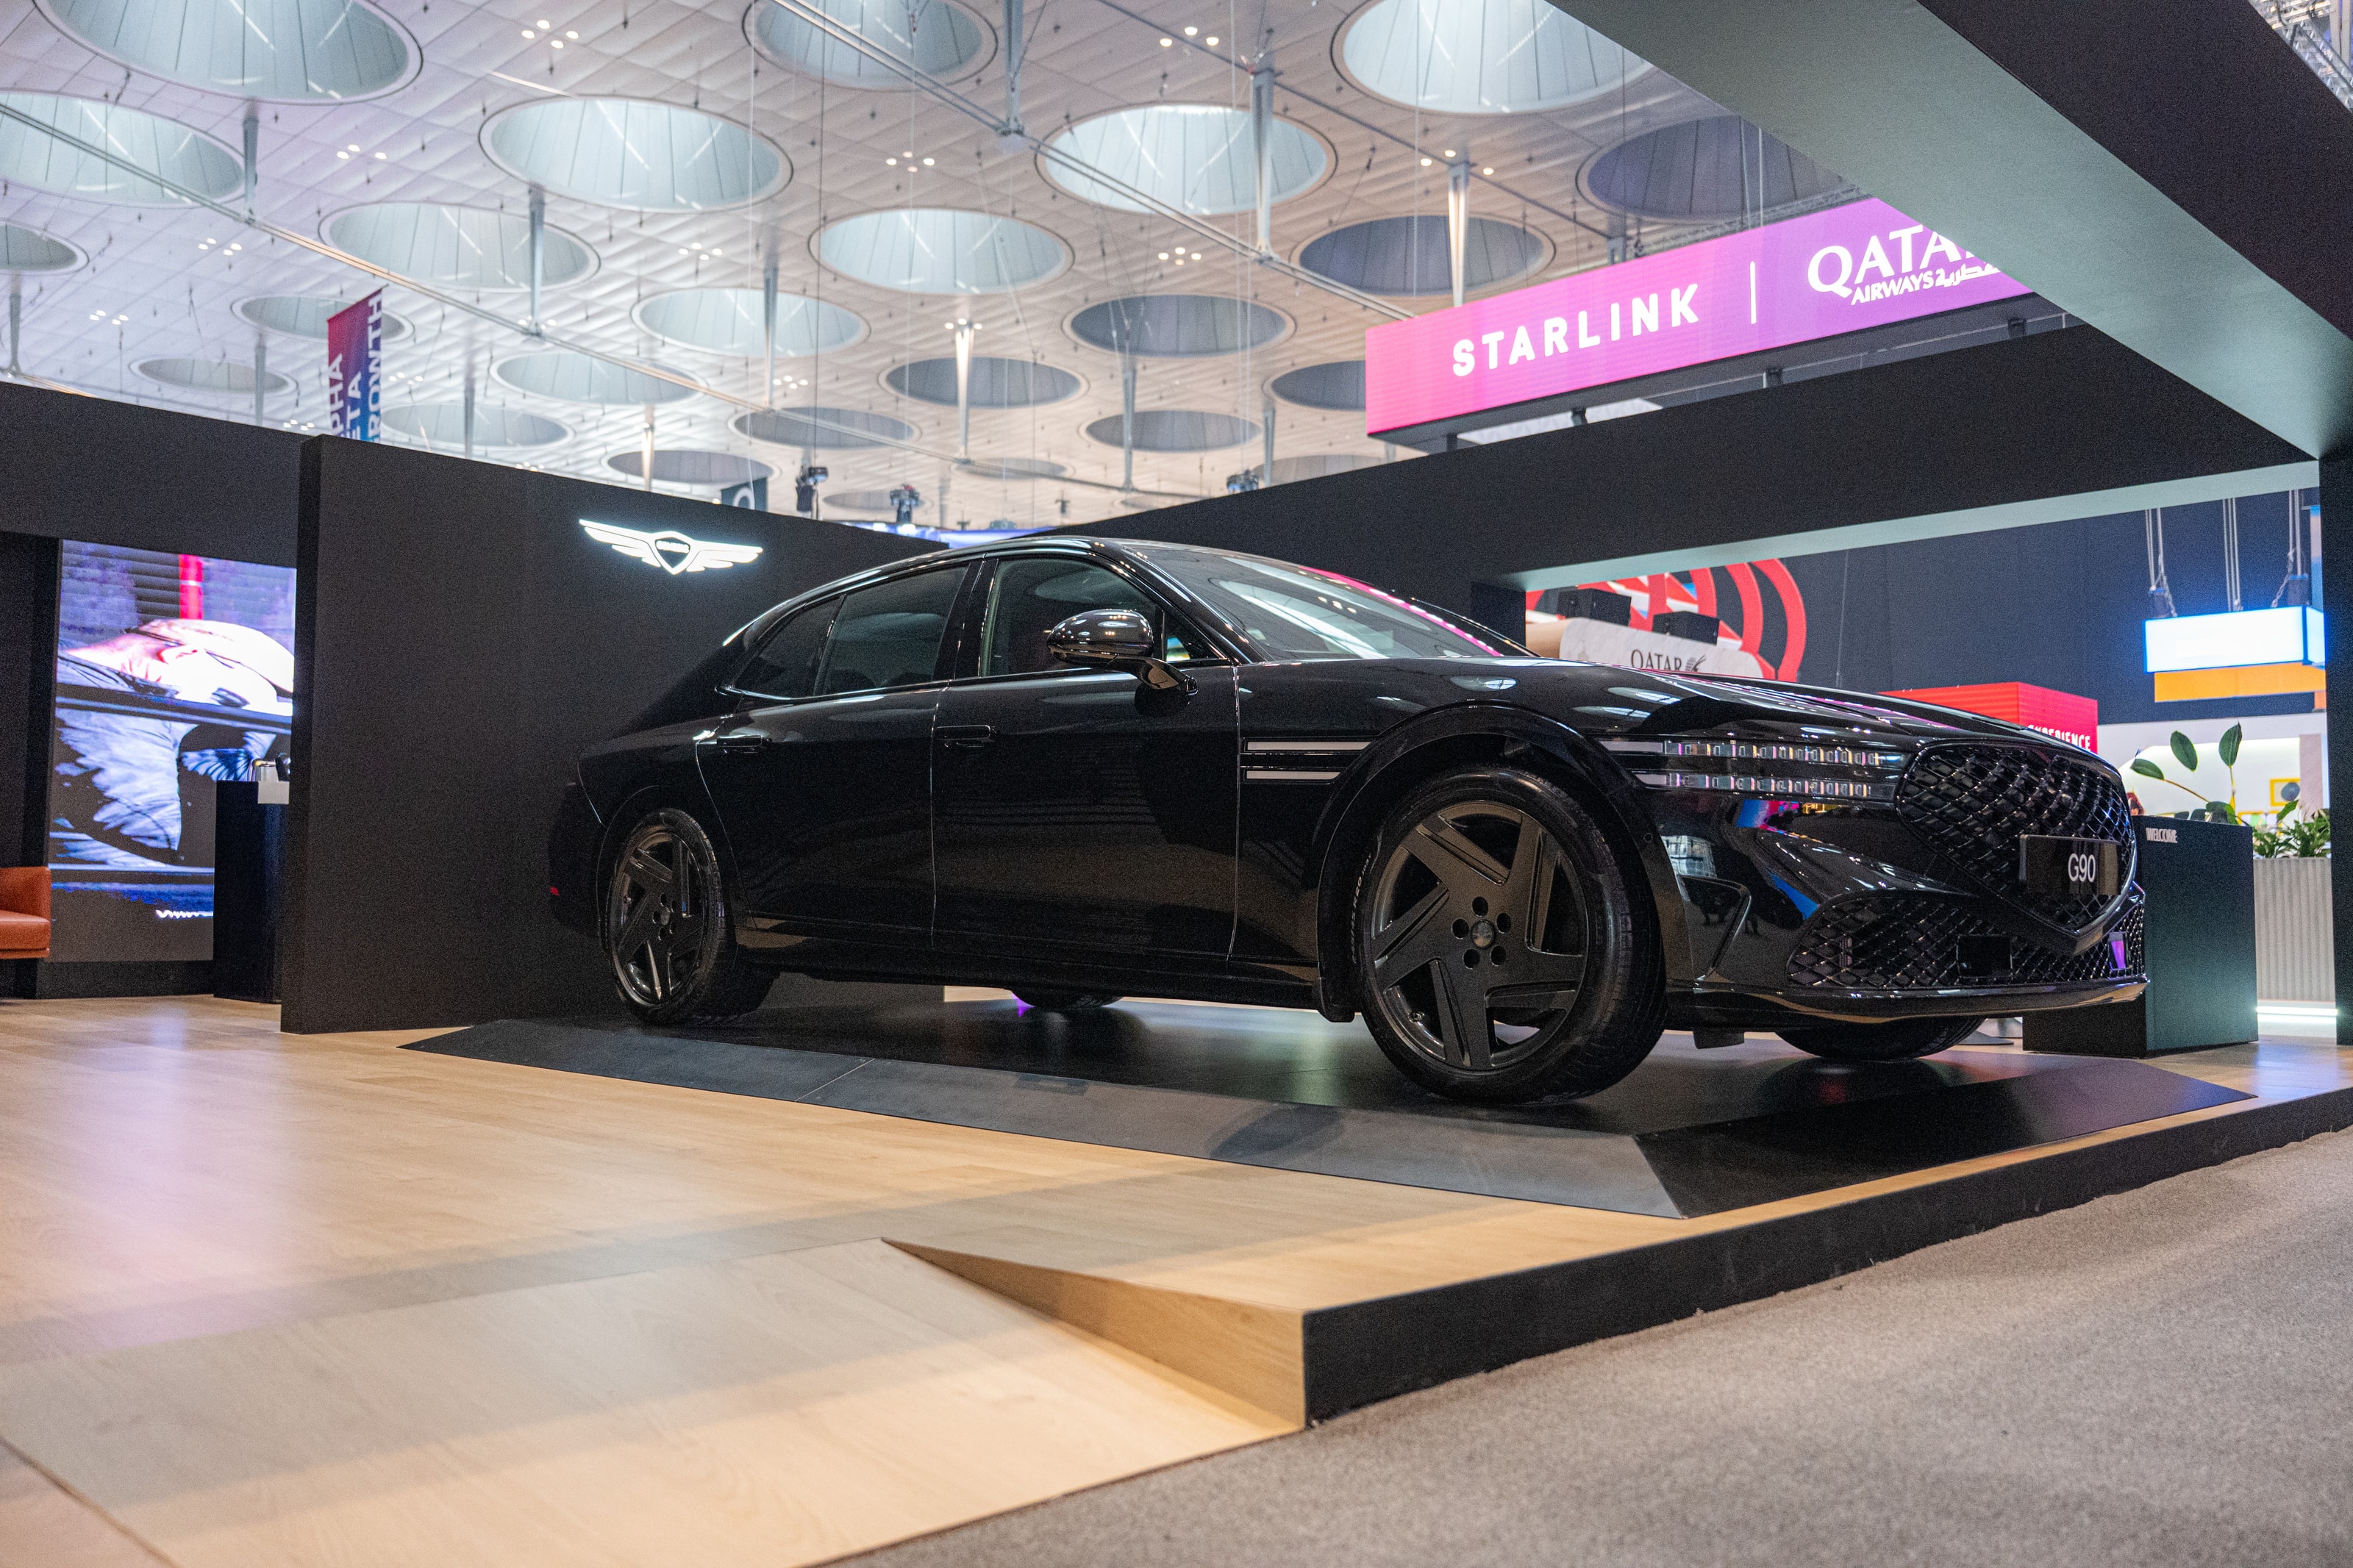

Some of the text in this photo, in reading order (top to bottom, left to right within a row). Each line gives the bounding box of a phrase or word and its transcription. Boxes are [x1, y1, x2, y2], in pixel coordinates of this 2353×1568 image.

[1807, 223, 1975, 298] QATA
[1851, 271, 1935, 306] AIRWAYS
[1452, 283, 1699, 377] STARLINK
[329, 353, 344, 436] PHA
[368, 295, 382, 443] ROWTH
[2068, 853, 2096, 882] G90
[2146, 827, 2178, 843] WELCOME
